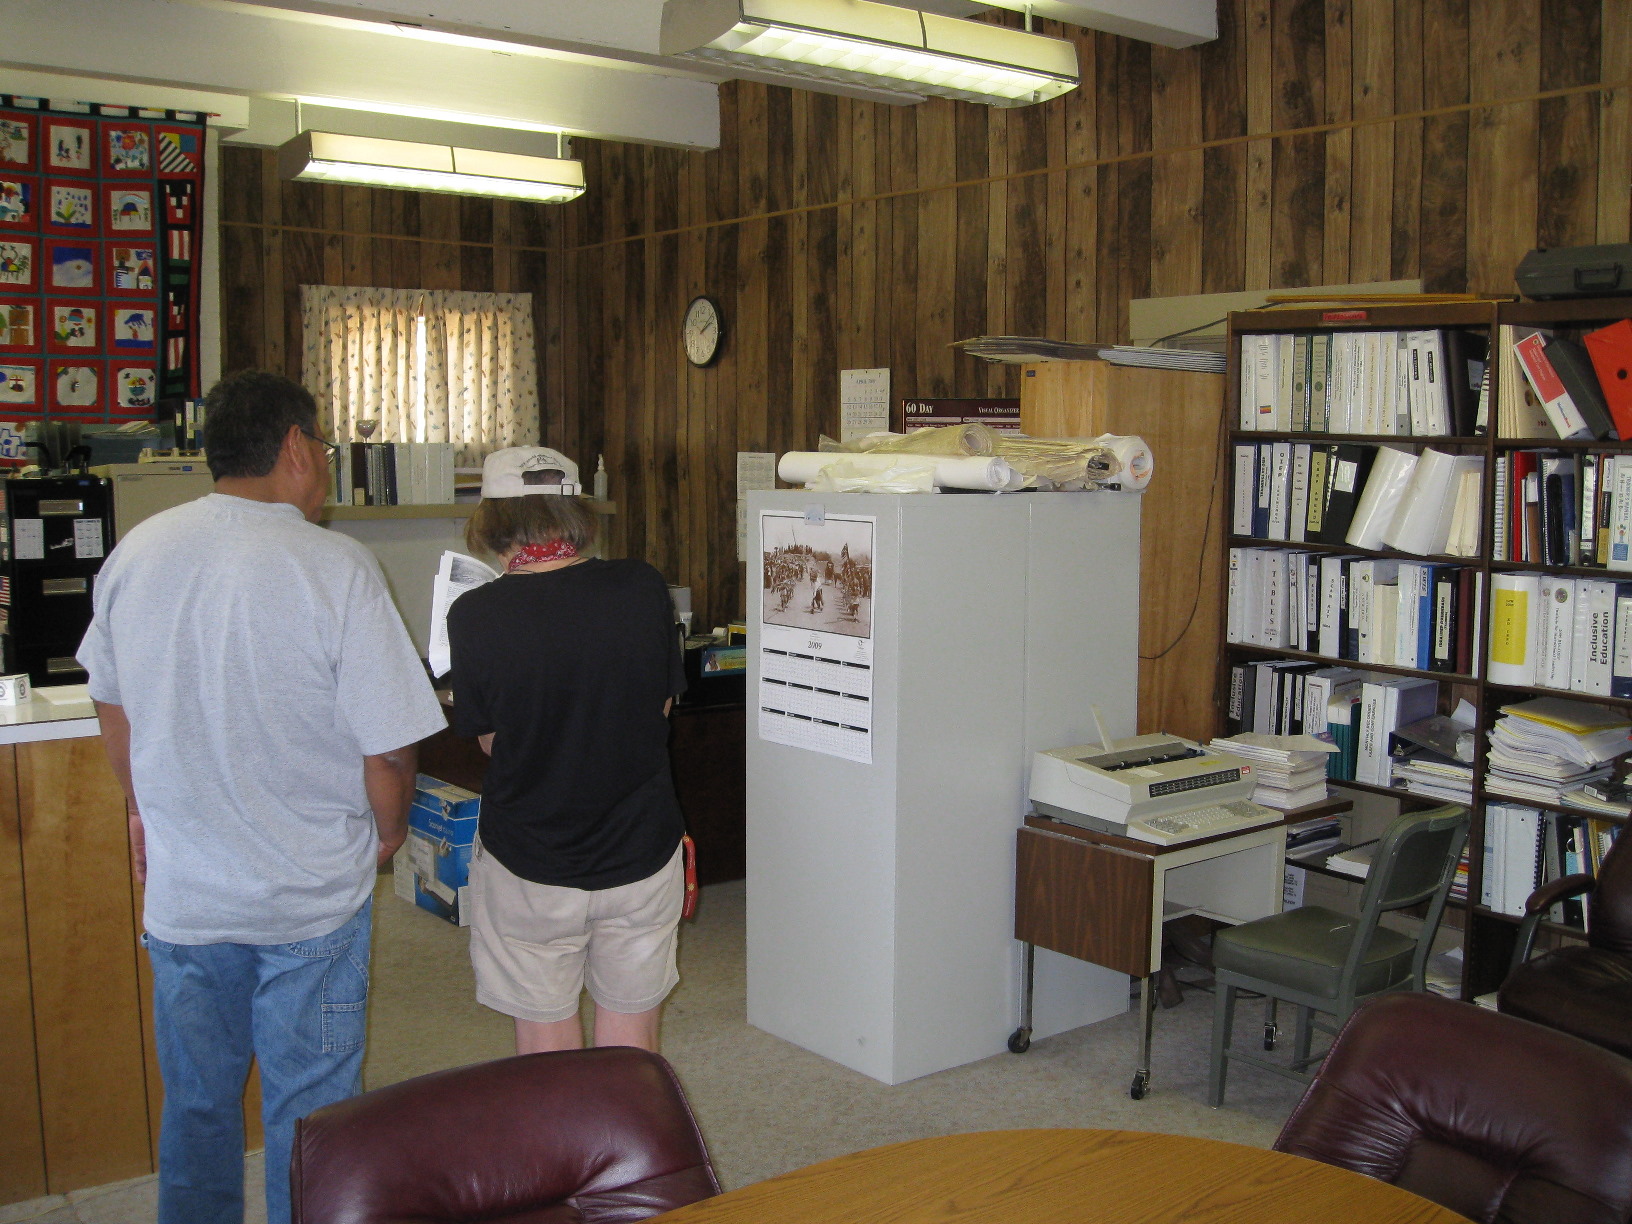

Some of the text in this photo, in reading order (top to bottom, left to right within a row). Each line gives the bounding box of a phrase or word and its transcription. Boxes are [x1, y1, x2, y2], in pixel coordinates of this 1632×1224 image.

[906, 402, 934, 414] 60 DAY
[1590, 612, 1598, 662] Inclusive
[1600, 612, 1608, 664] Education
